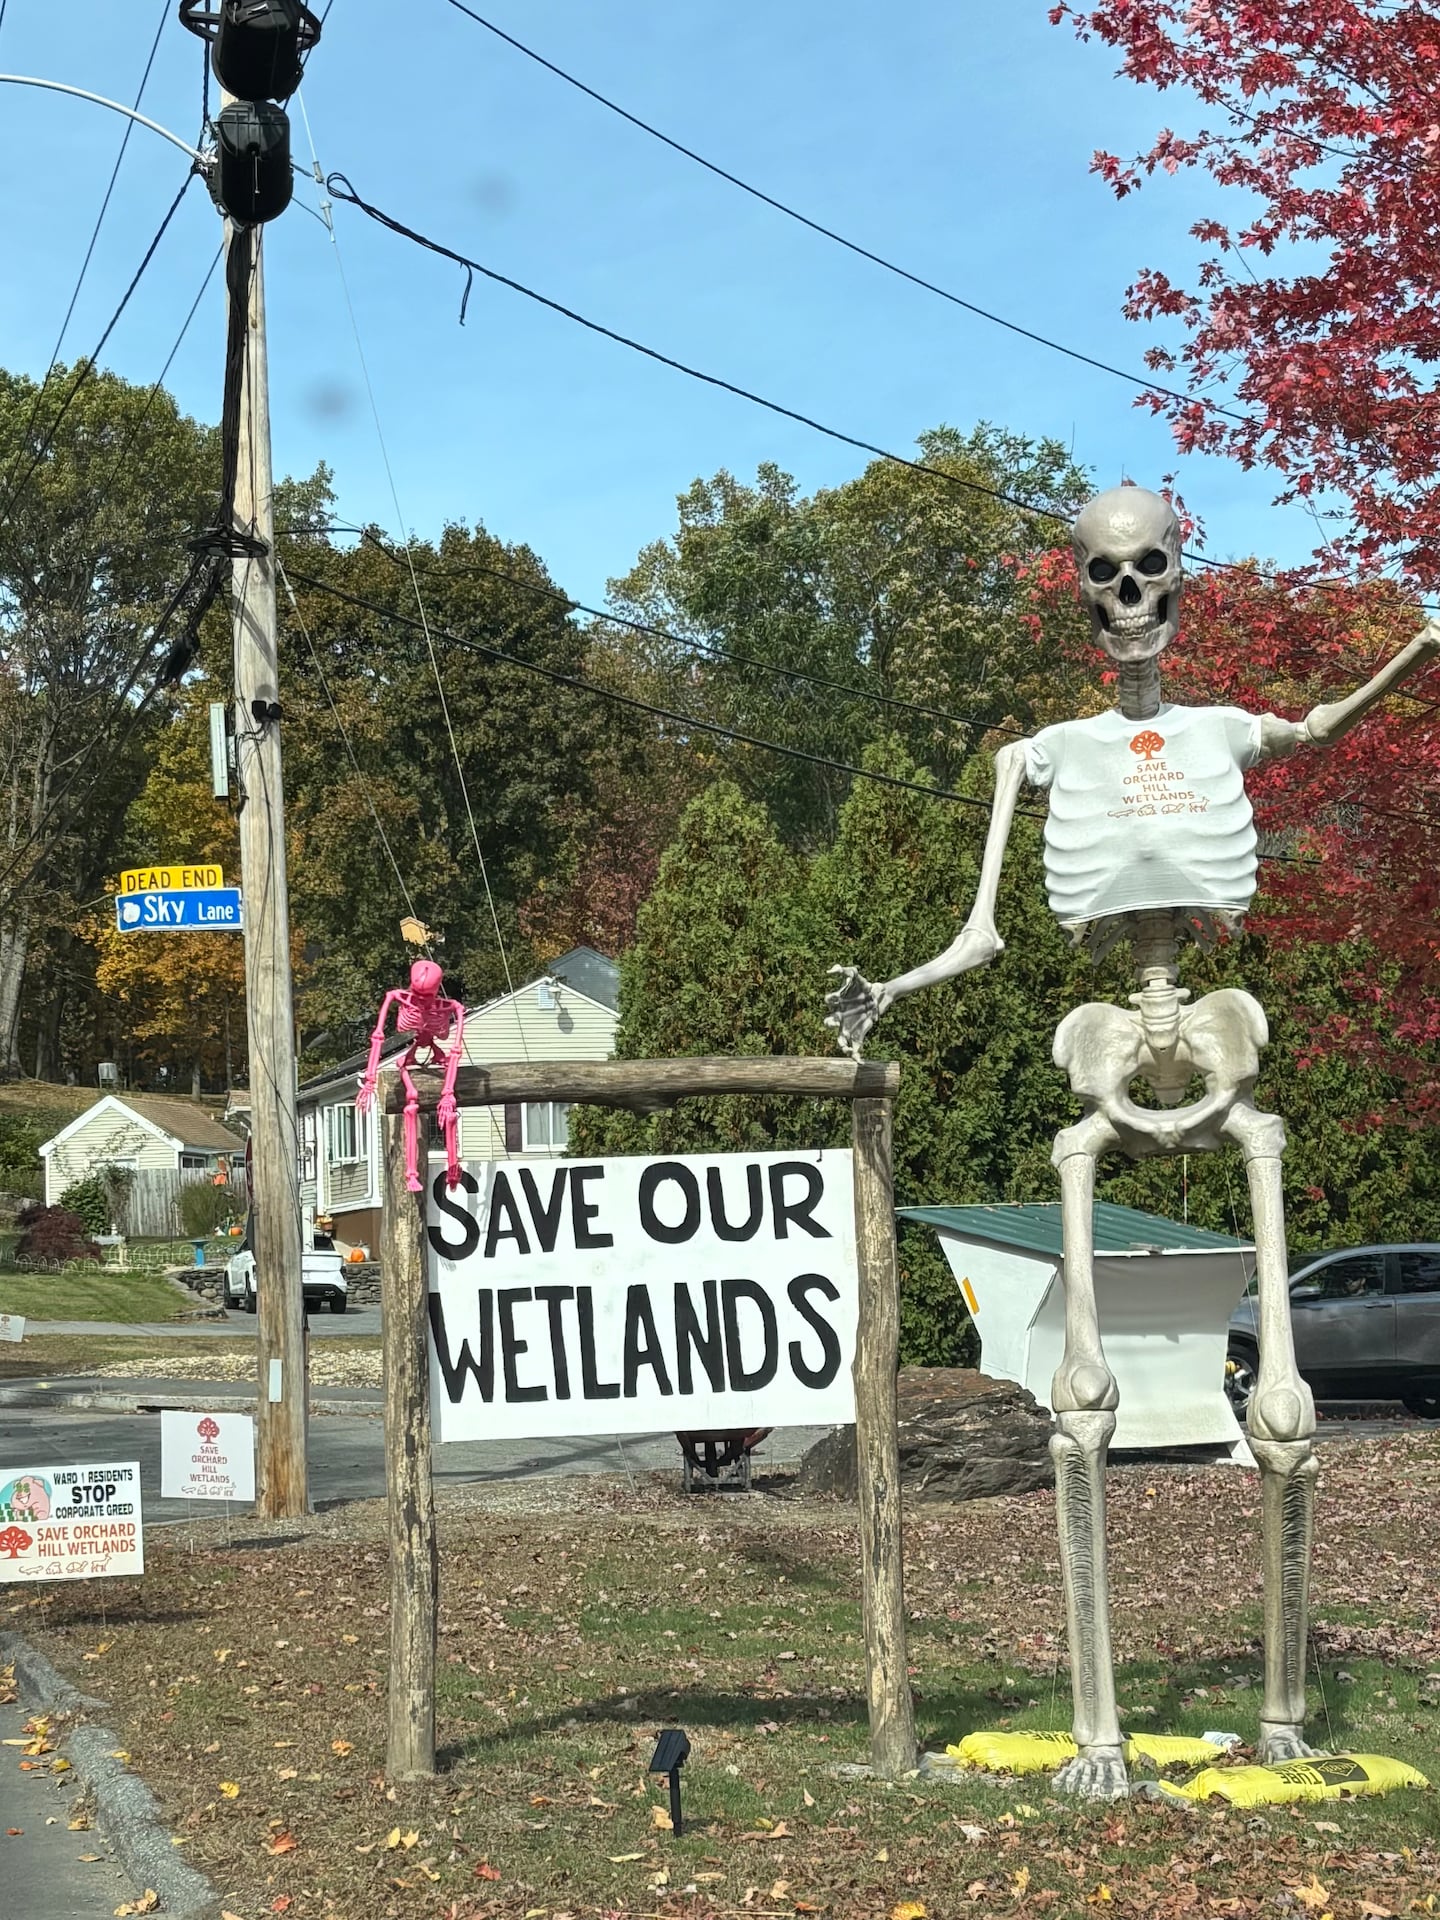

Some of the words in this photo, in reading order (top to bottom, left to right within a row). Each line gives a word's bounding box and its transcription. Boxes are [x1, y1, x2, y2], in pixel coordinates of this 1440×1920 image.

[1137, 762, 1167, 773] SAVE
[1123, 772, 1184, 785] ORCHARD
[1143, 784, 1170, 792] HILL
[1122, 791, 1195, 804] WETLANDS
[127, 872, 170, 892] DEAD
[183, 870, 216, 887] END
[144, 895, 185, 923] Sky
[198, 902, 234, 920] Lane
[428, 1165, 614, 1260] SAVE
[639, 1161, 833, 1244] OUR
[428, 1273, 842, 1404] WETLANDS
[200, 1446, 218, 1454] SAVE
[192, 1455, 228, 1464] ORCHARD
[202, 1465, 217, 1474] HILL
[54, 1472, 78, 1485] WARD
[81, 1473, 85, 1483] 1
[88, 1469, 133, 1482] RESIDENTS
[190, 1474, 230, 1484] WETLANDS
[72, 1484, 116, 1504] STOP
[56, 1506, 104, 1519] CORPORATE
[106, 1504, 134, 1516] GREED
[37, 1526, 68, 1542] SAVE
[73, 1523, 136, 1540] ORCHARD
[38, 1544, 65, 1557] HILL
[68, 1539, 136, 1556] WETLANDS
[1274, 1772, 1322, 1784] TUBE
